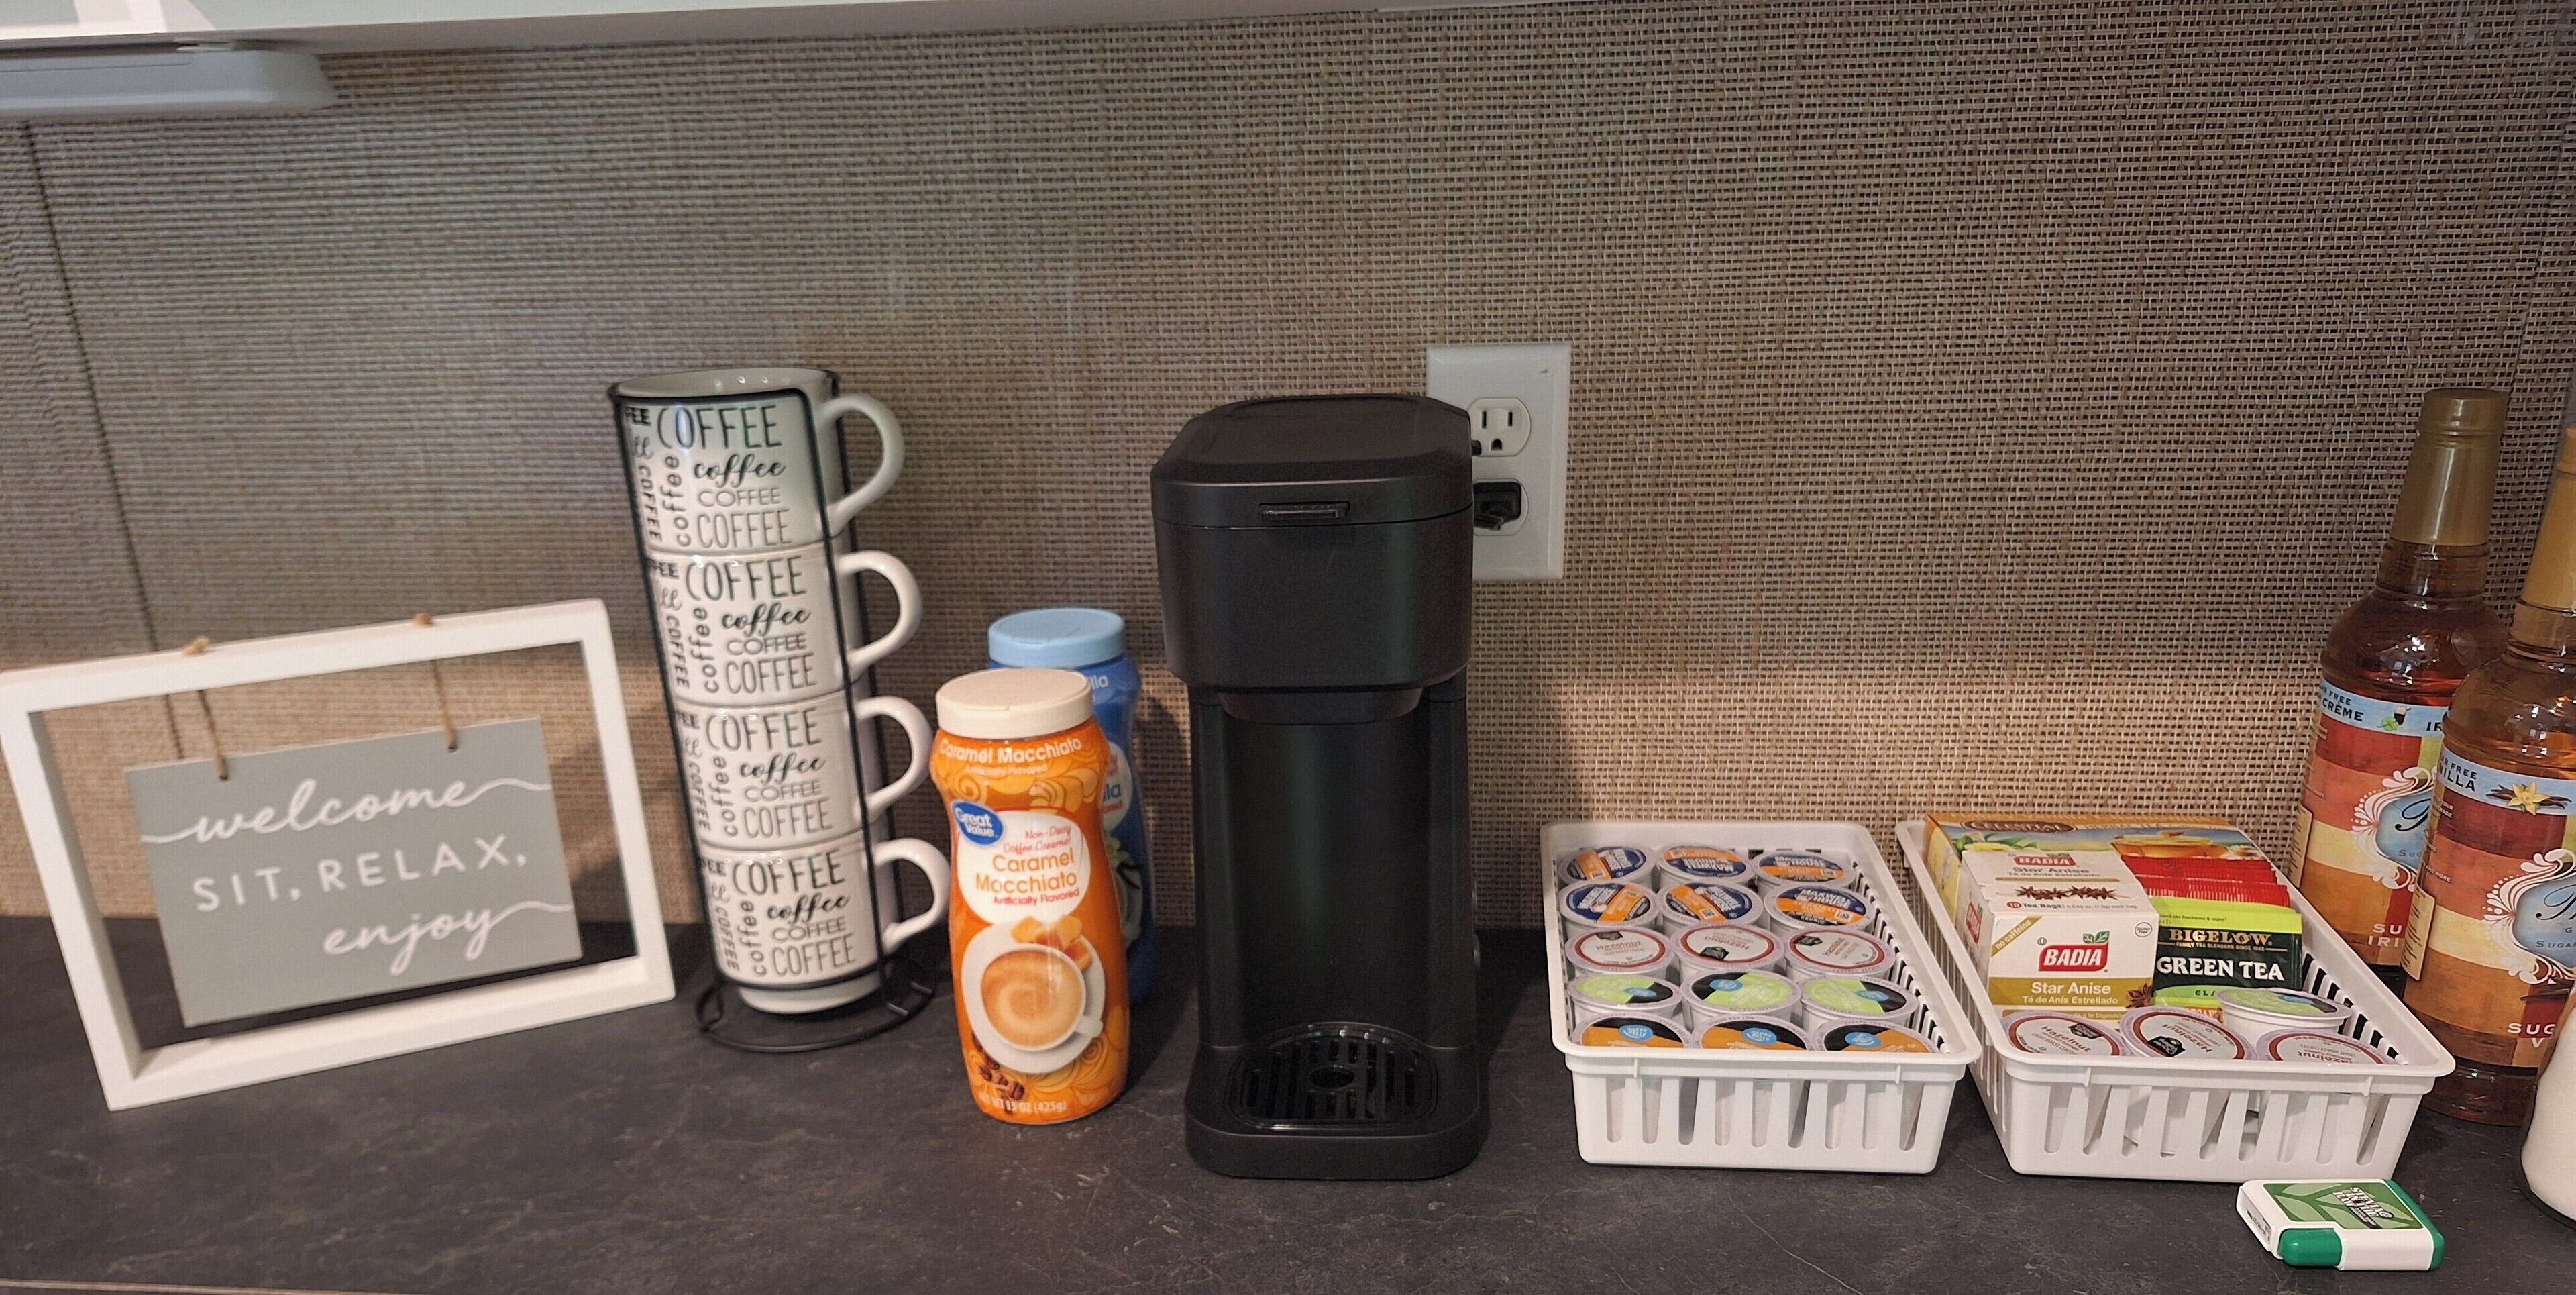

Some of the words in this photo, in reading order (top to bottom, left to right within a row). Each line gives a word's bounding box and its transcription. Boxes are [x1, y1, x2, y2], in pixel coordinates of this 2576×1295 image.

[657, 405, 782, 449] COFFEE
[694, 454, 786, 488] coffee
[661, 455, 692, 548] coffee
[698, 488, 781, 507] COFFEE
[698, 509, 794, 548] COFFEE
[686, 556, 808, 601] COFFEE
[721, 603, 812, 636] coffee
[688, 607, 720, 694] coffee
[727, 633, 807, 656] COFFEE
[726, 653, 817, 694] COFFEE
[2322, 697, 2364, 722] CRÈME
[2328, 691, 2352, 706] FREE
[706, 707, 822, 752] COFFEE
[939, 739, 993, 764] Caramel
[998, 737, 1083, 764] Macchiato
[740, 752, 826, 785] coffee
[2439, 763, 2475, 792] NILLA
[2451, 762, 2477, 779] FREE
[708, 756, 739, 837] coffee
[744, 779, 822, 802] COFFEE
[168, 778, 517, 843] welcome
[743, 797, 833, 839] COFFEE
[955, 807, 992, 827] Great
[966, 821, 995, 838] Value
[192, 868, 301, 912] SIT,
[319, 834, 527, 894] RELAX,
[733, 849, 845, 896] COFFEE
[993, 848, 1075, 872] Caramel
[2018, 857, 2070, 866] BADIA
[975, 873, 1077, 894] Macchiato
[767, 893, 850, 925] coffee
[993, 894, 1038, 906] Artificially
[1040, 889, 1079, 904] Flavored
[322, 900, 537, 976] enjoy
[739, 901, 768, 977] coffee
[772, 916, 847, 943] COFFEE
[1994, 939, 2006, 951] no
[2004, 919, 2033, 945] caffeine
[2169, 929, 2273, 946] BIGELOW
[2367, 936, 2400, 948] IRI
[772, 933, 856, 978] COFFEE
[2043, 949, 2102, 966] BADIA
[2156, 956, 2234, 978] GREEN
[2239, 960, 2285, 982] TEA
[2031, 982, 2065, 994] Star
[2066, 982, 2112, 994] Anise
[2035, 995, 2047, 1003] de
[2072, 995, 2118, 1004] Estrellado
[2041, 1025, 2092, 1053] Hazelnut
[2161, 1023, 2212, 1053] Hazelnut
[2507, 1023, 2556, 1035] SUG
[2297, 1051, 2352, 1064] azelnut
[2348, 1187, 2385, 1212] STEVIA
